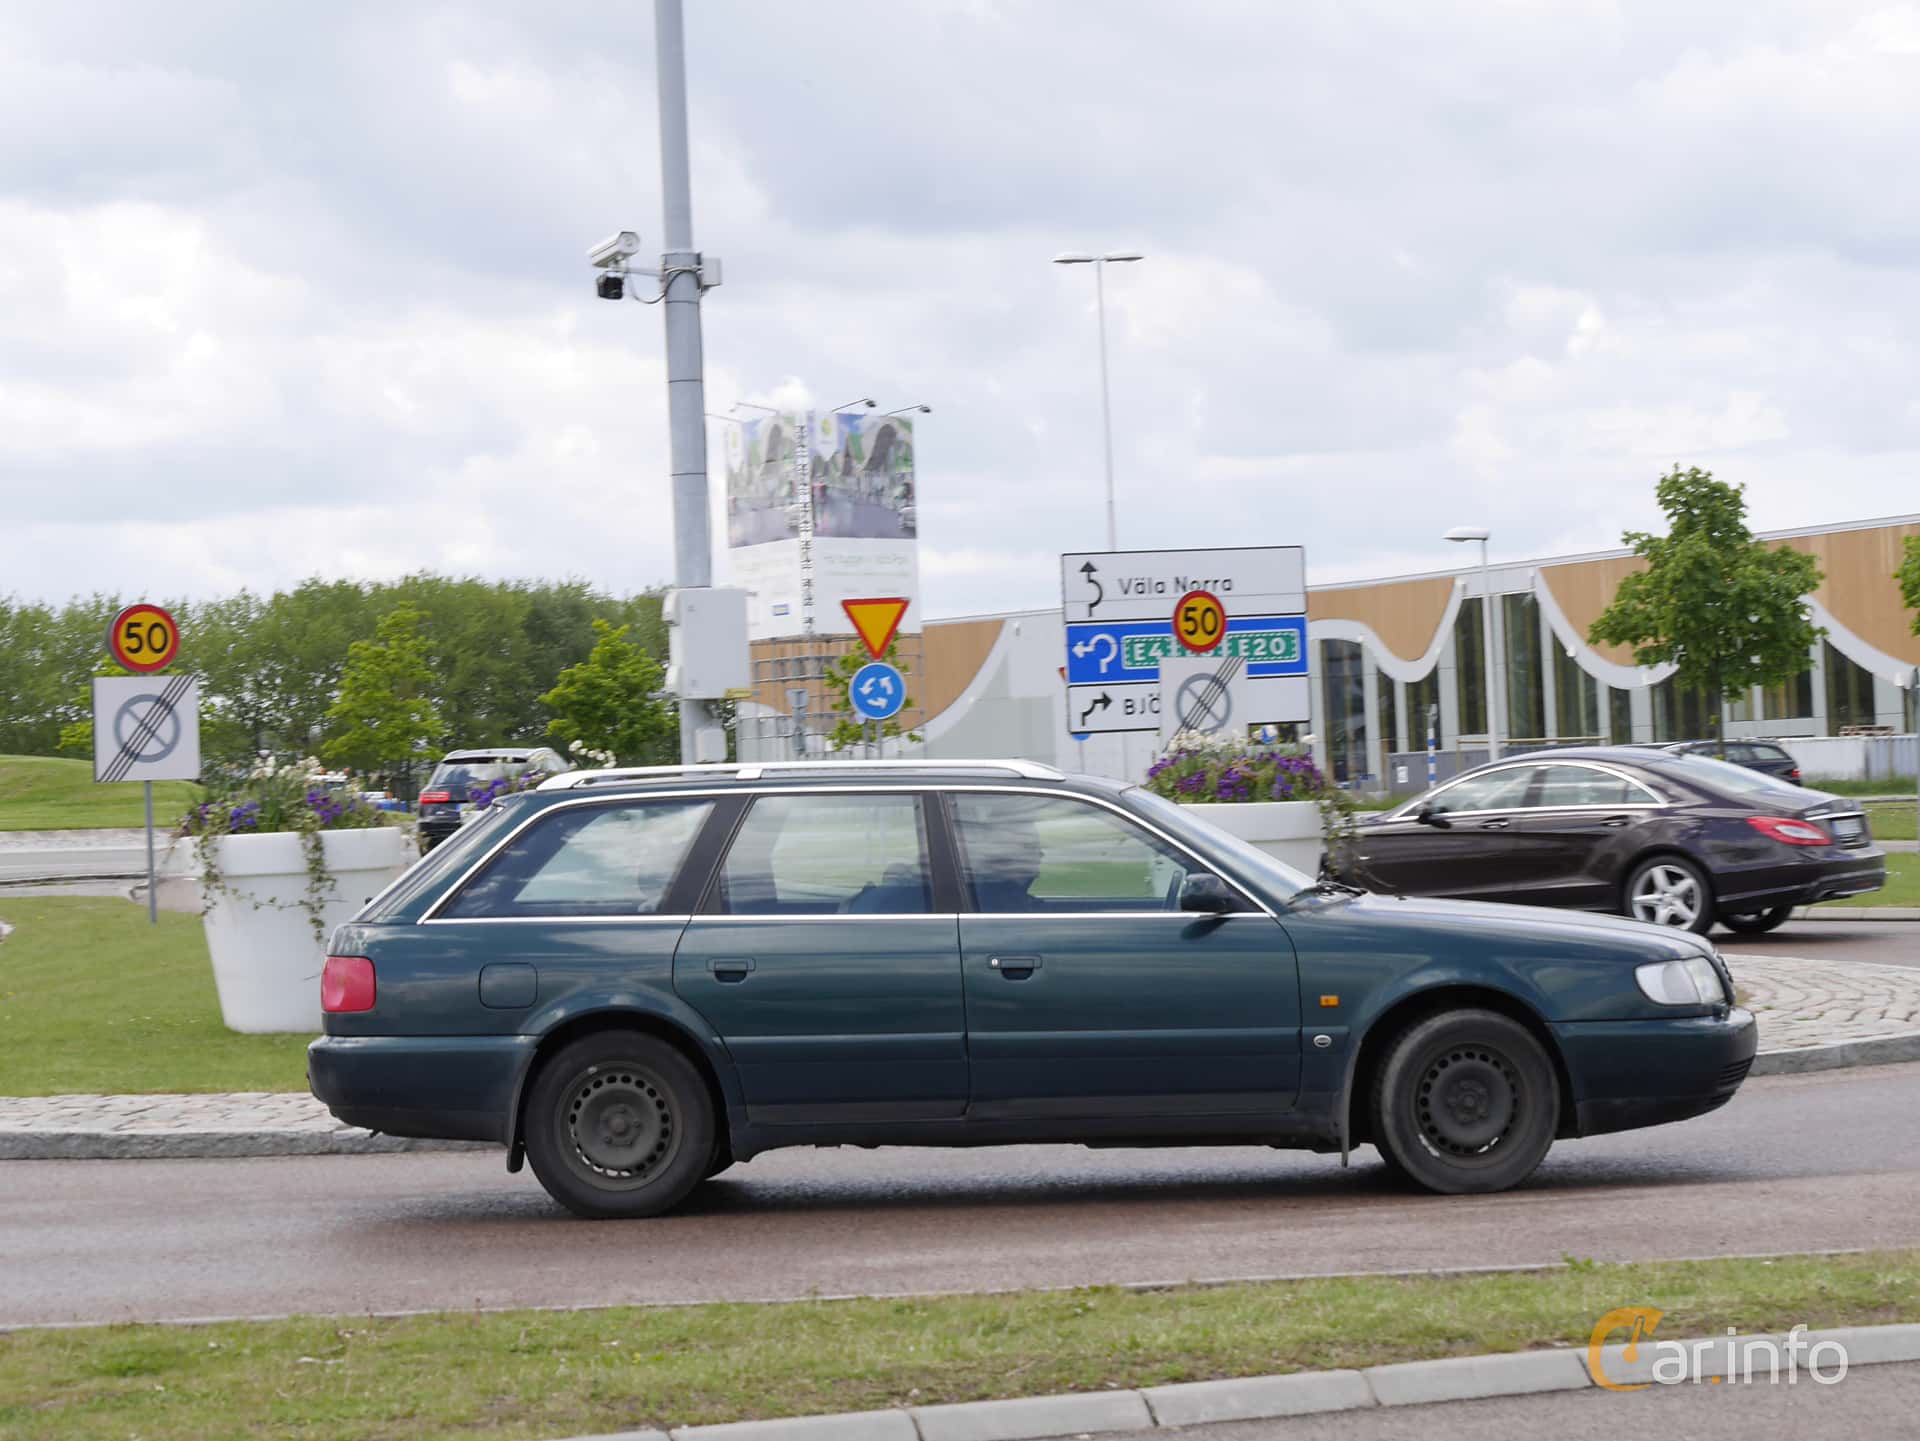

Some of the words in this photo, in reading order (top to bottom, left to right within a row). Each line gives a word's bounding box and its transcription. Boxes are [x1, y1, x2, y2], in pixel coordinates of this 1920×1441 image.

[1118, 577, 1165, 595] Väla
[1174, 576, 1232, 593] Norra
[1184, 606, 1219, 636] 50
[125, 622, 168, 654] 50
[1133, 641, 1164, 661] E4
[1238, 637, 1286, 657] E20
